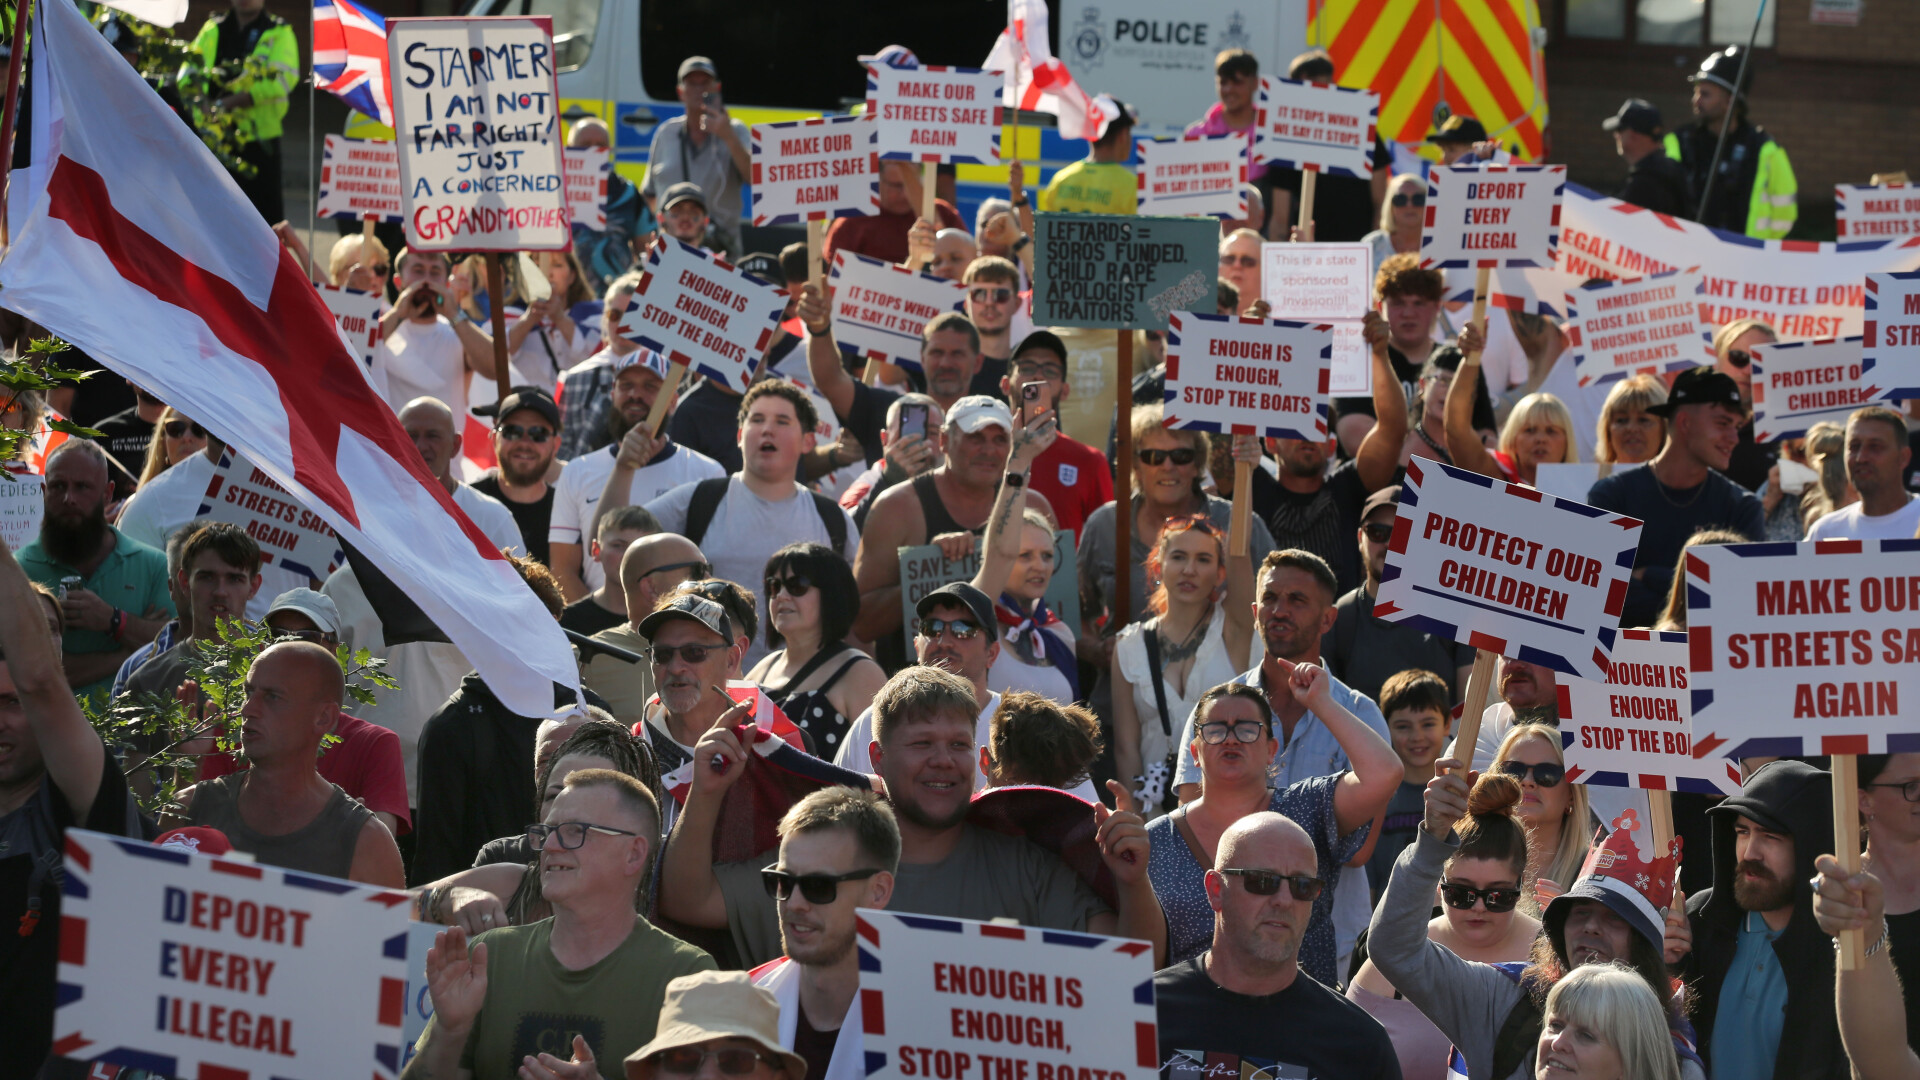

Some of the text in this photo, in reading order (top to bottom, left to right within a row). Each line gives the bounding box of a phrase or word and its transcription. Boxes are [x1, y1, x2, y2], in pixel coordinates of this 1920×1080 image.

[1115, 19, 1208, 46] POLICE
[404, 42, 552, 88] STARMER
[898, 81, 976, 100] MAKE OUR
[425, 92, 550, 121] I AM NOT
[884, 104, 987, 125] STREETS SAFE
[1278, 106, 1360, 129] IT STOPS WHEN
[414, 115, 555, 154] FAR RIGHT!
[780, 134, 852, 156] MAKE OUR
[910, 128, 957, 147] AGAIN
[1273, 123, 1360, 146] WE SAY IT STOPS
[336, 164, 364, 176] CLOSE
[367, 167, 382, 178] ALL
[457, 151, 525, 172] JUST
[768, 158, 864, 183] STREETS SAFE
[1155, 161, 1230, 177] IT STOPS WHEN
[336, 180, 379, 194] HOUSING
[413, 175, 561, 198] A CONCERNED
[796, 185, 839, 205] AGAIN
[1153, 177, 1233, 194] WE SAY IT STOPS
[1467, 182, 1526, 200] DEPORT
[349, 197, 399, 211] MIGRANTS
[1464, 207, 1511, 225] EVERY
[1864, 200, 1901, 214] MAKE
[414, 205, 569, 240] GRANDMOTHER
[1047, 221, 1132, 242] LEFTARDS
[1853, 219, 1909, 235] STREETS
[1047, 241, 1188, 264] SOROS FUNDED.
[1461, 232, 1517, 250] ILLEGAL
[1047, 262, 1157, 282] CHILD RAPE
[1275, 254, 1299, 266] This
[1326, 254, 1357, 266] state
[1558, 228, 1611, 262] EGAL
[1744, 283, 1809, 305] HOTEL
[678, 269, 749, 313] ENOUGH IS
[1046, 281, 1147, 303] APOLOGIST
[1282, 274, 1349, 288] sponsored
[849, 285, 941, 319] IT STOPS WHEN
[1597, 285, 1677, 312] IMMEDIATELY
[675, 293, 730, 333] ENOUGH,
[840, 302, 925, 336] WE SAY IT STO
[1046, 301, 1138, 322] TRAITORS.
[1586, 301, 1695, 333] CLOSE ALL HOTELS
[342, 315, 366, 334] OUR
[642, 303, 747, 364] STOP THE BOATS
[1591, 321, 1695, 352] HOUSING ILLEGAL
[1781, 314, 1844, 338] FIRST
[1209, 338, 1293, 363] ENOUGH IS
[1613, 344, 1679, 367] MIGRANTS
[1216, 364, 1283, 389] ENOUGH,
[1771, 363, 1862, 390] PROTECT O
[1184, 386, 1311, 414] STOP THE BOATS
[225, 484, 298, 523] STREETS
[246, 519, 299, 552] AGAIN
[1423, 511, 1603, 588] PROTECT OUR
[908, 557, 952, 580] SAVE
[1438, 559, 1569, 621] CHILDREN
[1756, 578, 1852, 616] MAKE
[1727, 629, 1873, 669] STREETS
[1605, 661, 1688, 690] NOUGH IS
[1609, 694, 1683, 725] ENOUGH,
[1793, 681, 1898, 719] AGAIN
[1580, 725, 1691, 756] STOP THE BO
[161, 885, 312, 949] DEPORT
[159, 940, 276, 997] EVERY
[933, 961, 1084, 1009] ENOUGH IS
[156, 995, 297, 1058] ILLEGAL
[950, 1008, 1072, 1054] ENOUGH,
[898, 1045, 971, 1080] STOP
[977, 1054, 1029, 1080] THE
